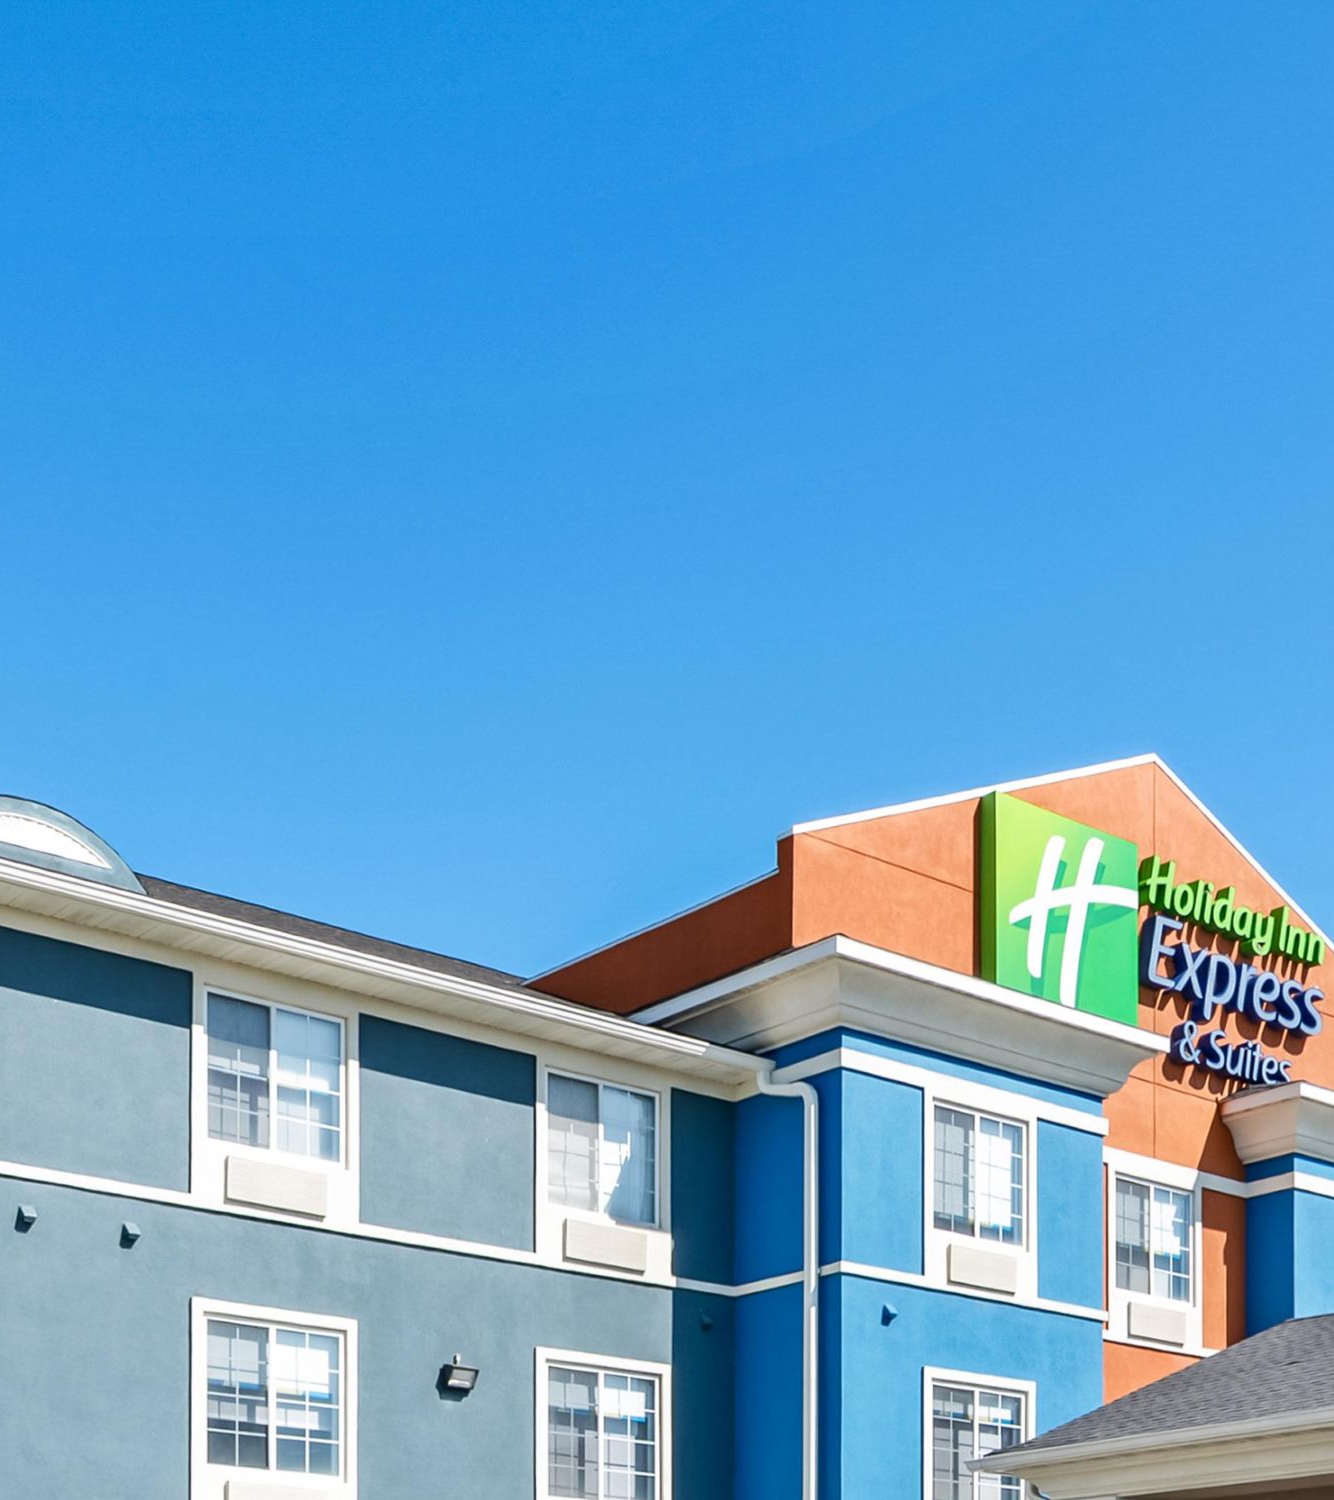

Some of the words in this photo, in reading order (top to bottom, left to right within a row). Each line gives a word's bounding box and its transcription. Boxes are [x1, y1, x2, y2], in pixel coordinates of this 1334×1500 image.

[1145, 854, 1275, 956] Holiday
[1279, 904, 1326, 966] Inn
[1147, 914, 1324, 1036] Express
[1179, 1020, 1201, 1065] &
[1205, 1029, 1292, 1085] Suites
